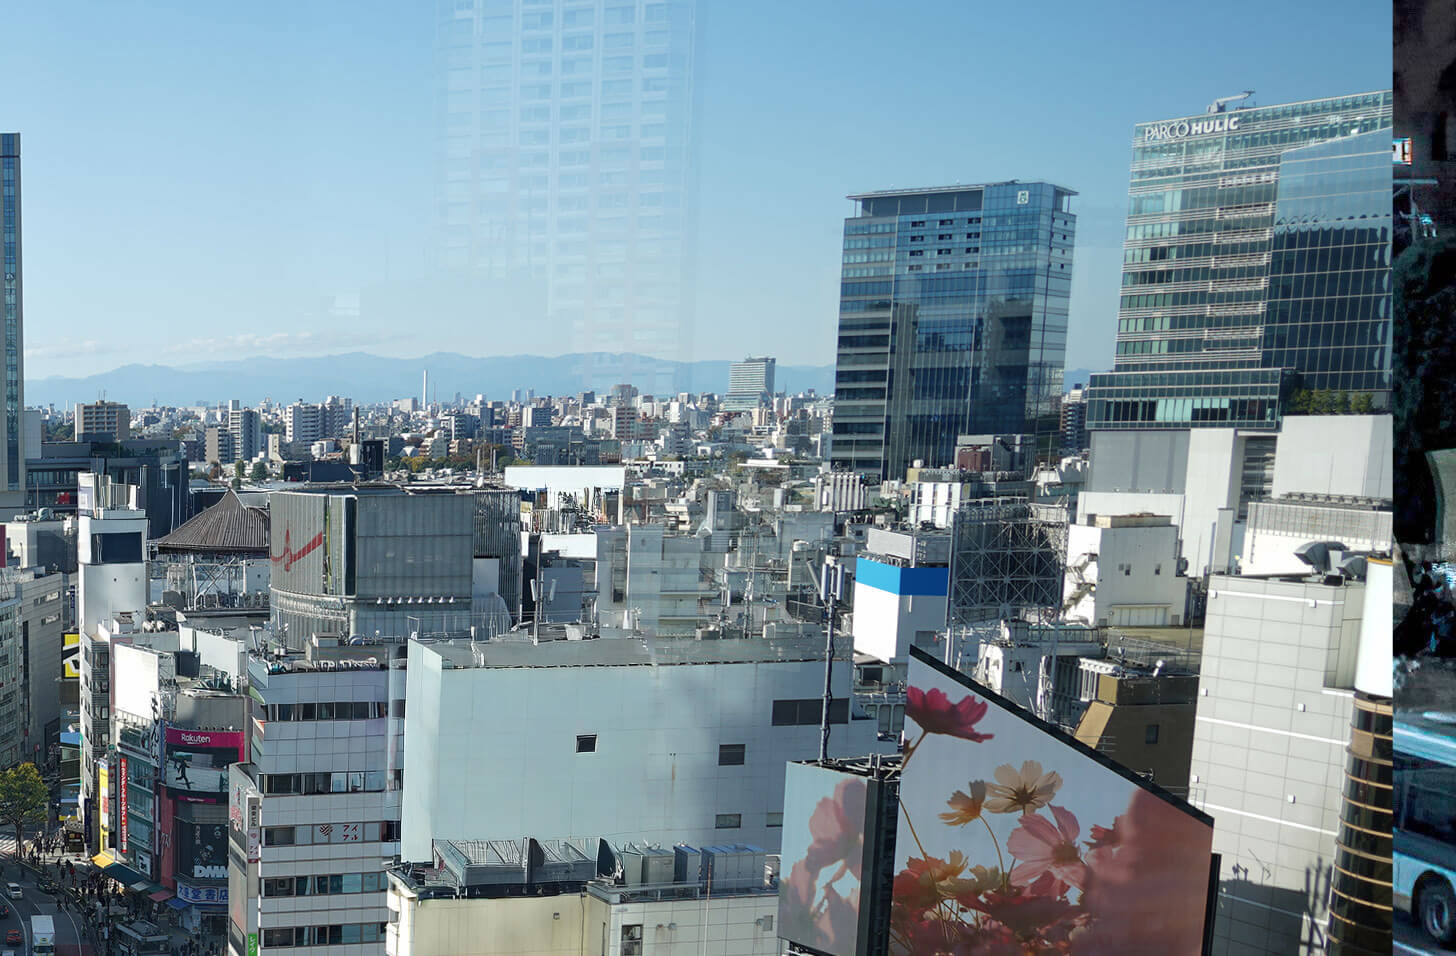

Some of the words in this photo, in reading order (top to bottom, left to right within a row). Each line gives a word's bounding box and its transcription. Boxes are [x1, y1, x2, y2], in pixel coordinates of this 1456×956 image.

[1144, 121, 1190, 141] PARCO
[1191, 117, 1240, 135] HULIC
[181, 733, 211, 743] Rakuten
